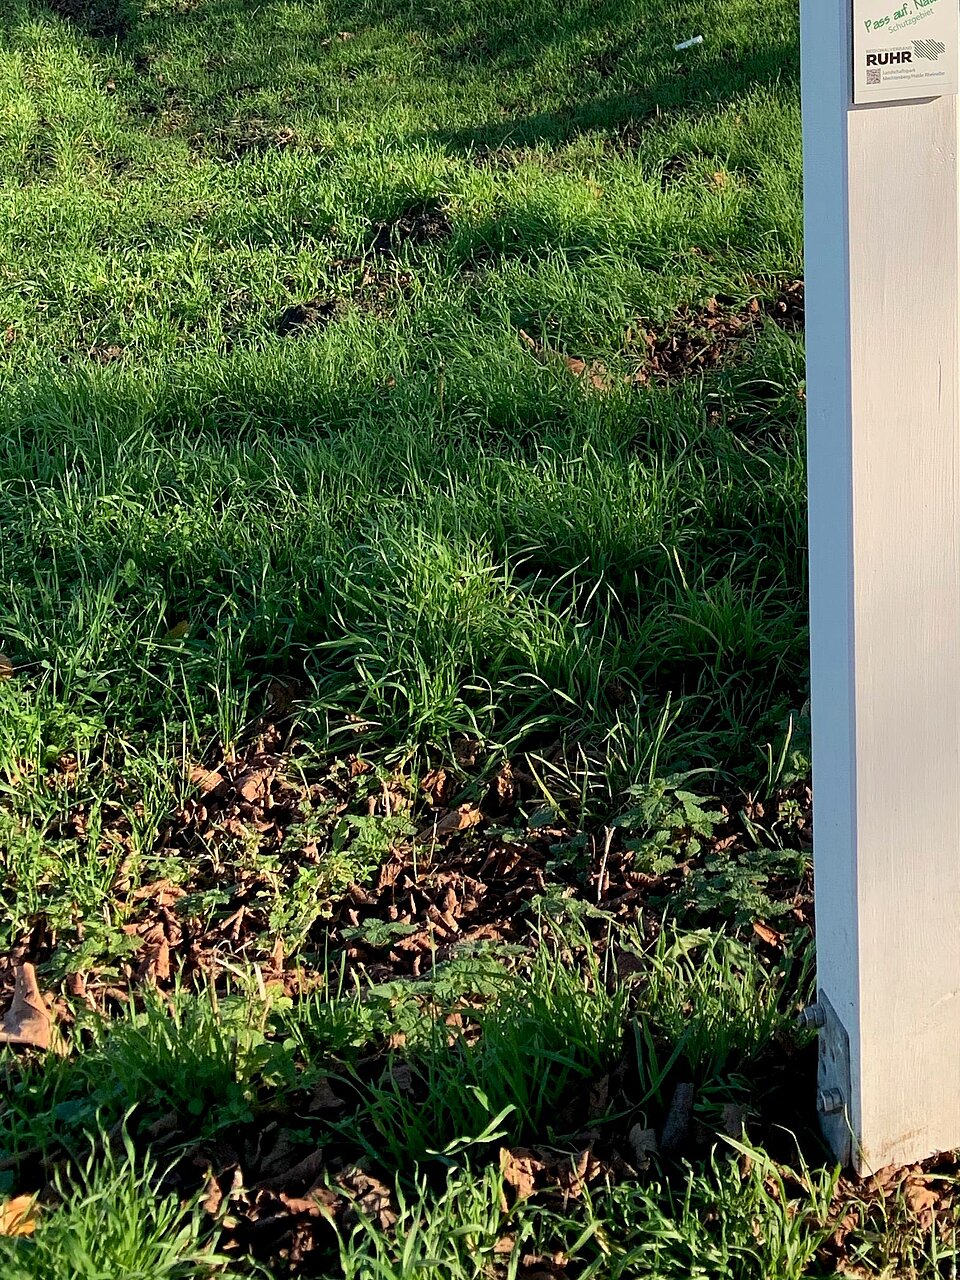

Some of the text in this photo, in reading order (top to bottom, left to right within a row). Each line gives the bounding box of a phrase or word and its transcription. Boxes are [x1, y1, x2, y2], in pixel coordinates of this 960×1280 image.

[864, 16, 890, 32] Pass
[894, 3, 912, 20] auf,
[888, 8, 934, 33] Schutzgebiet
[866, 52, 912, 66] RUHR
